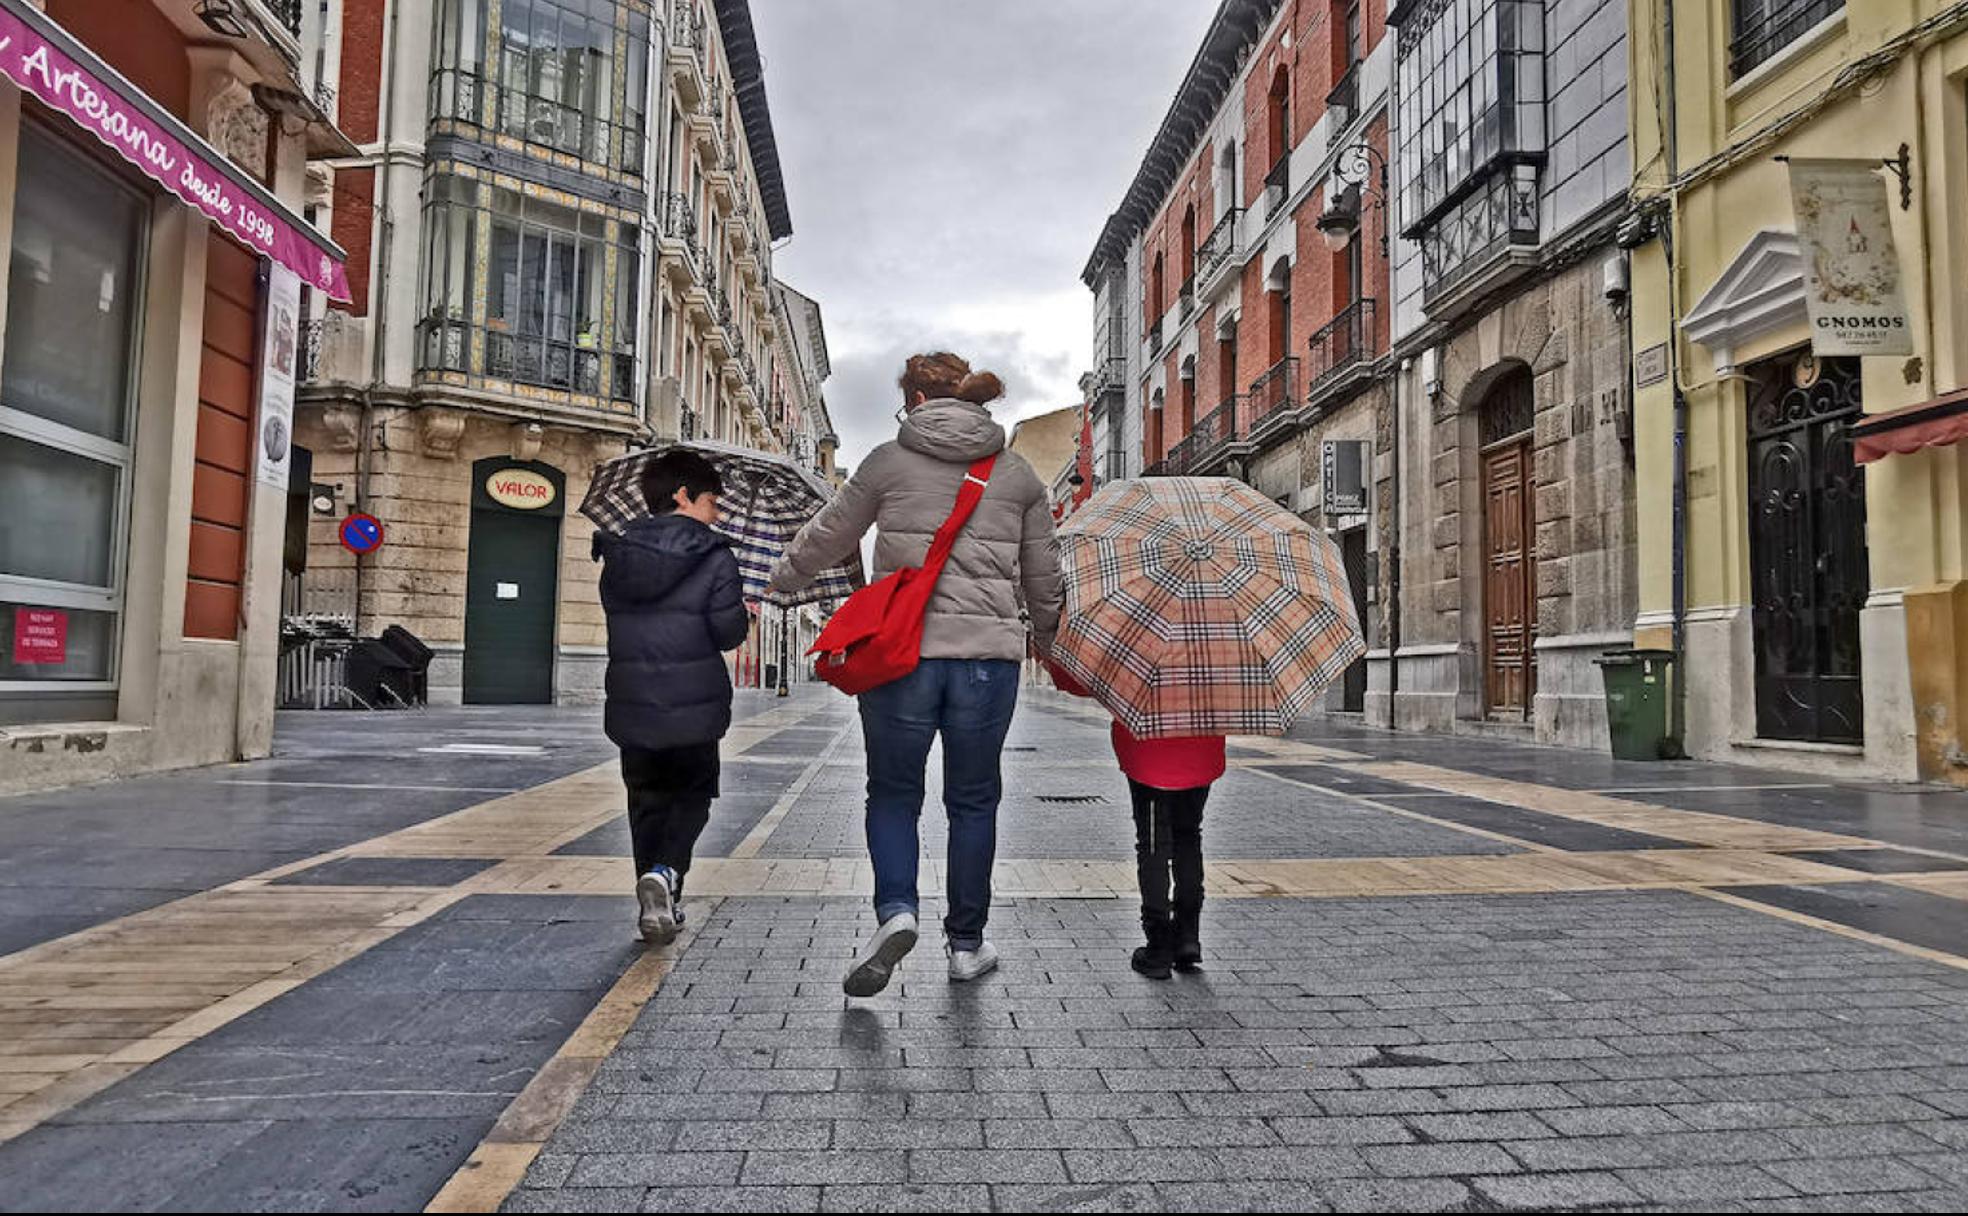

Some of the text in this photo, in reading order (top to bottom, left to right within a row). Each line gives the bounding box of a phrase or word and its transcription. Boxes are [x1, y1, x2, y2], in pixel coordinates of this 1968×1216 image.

[20, 45, 275, 247] Artesana desde 1998
[1816, 315, 1905, 329] GNOMOS
[494, 479, 548, 499] VALOR
